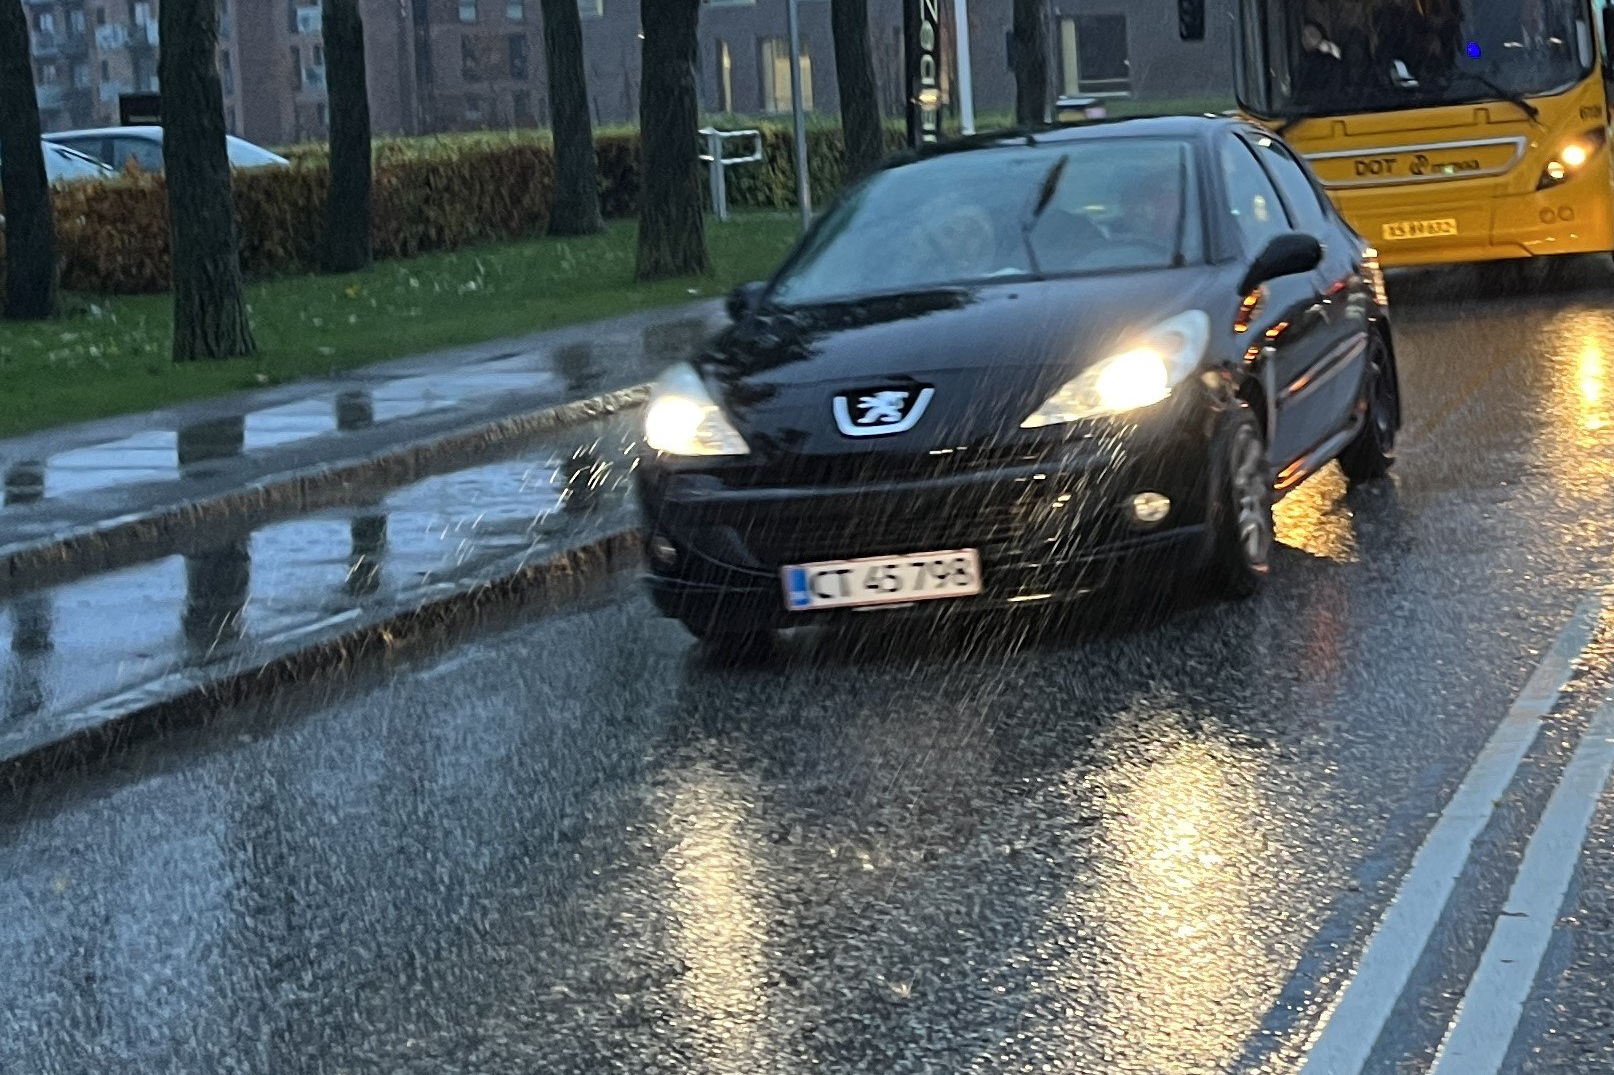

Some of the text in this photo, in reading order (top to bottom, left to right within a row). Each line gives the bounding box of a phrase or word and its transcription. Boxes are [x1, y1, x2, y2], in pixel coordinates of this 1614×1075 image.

[1354, 158, 1397, 175] DOT
[809, 557, 972, 599] CT 45 798
